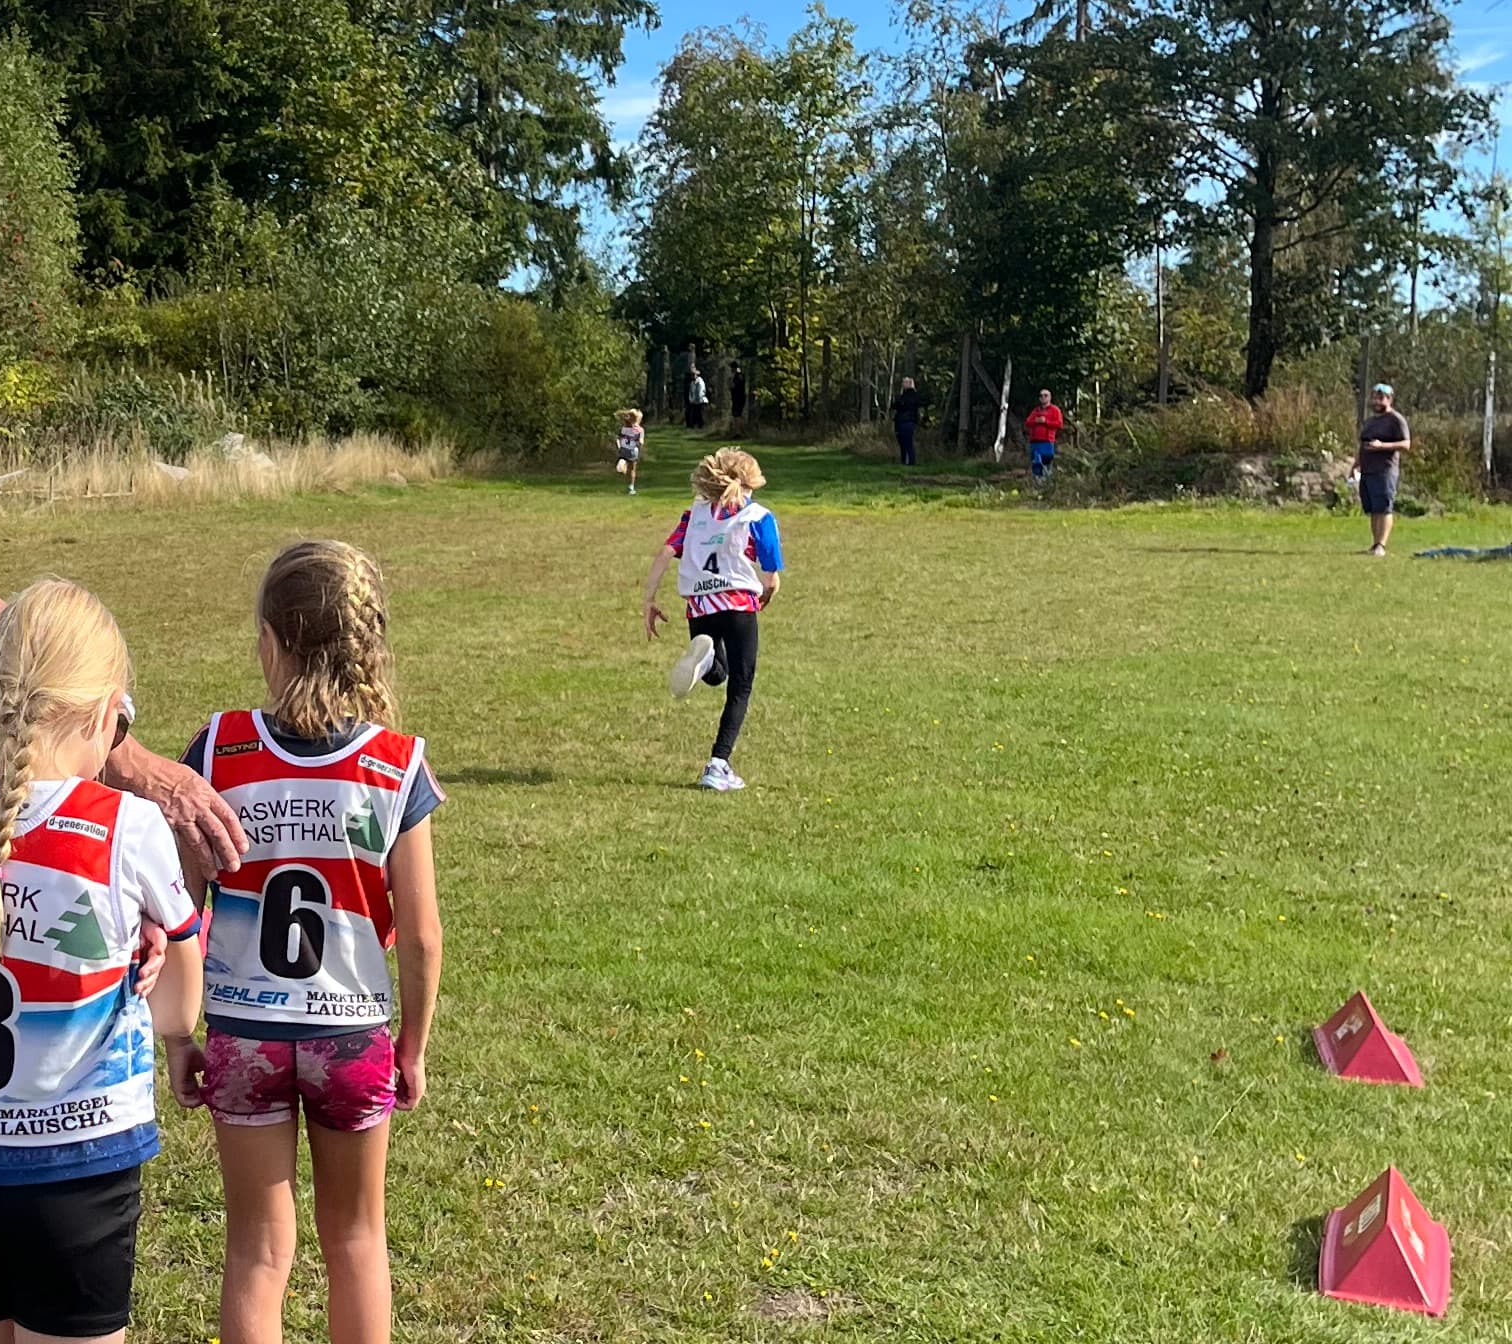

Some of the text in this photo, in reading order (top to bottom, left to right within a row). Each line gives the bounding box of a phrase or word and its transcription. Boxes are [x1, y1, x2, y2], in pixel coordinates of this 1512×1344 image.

[702, 552, 719, 574] 4
[239, 799, 335, 822] ASWERK
[49, 817, 106, 837] d-generation
[245, 823, 345, 844] NSTTHAL
[260, 869, 326, 979] 6
[306, 1002, 386, 1016] LAUSCHA
[0, 1095, 113, 1119] MARKTIEGEL
[1, 1110, 113, 1135] LAUSCHA
